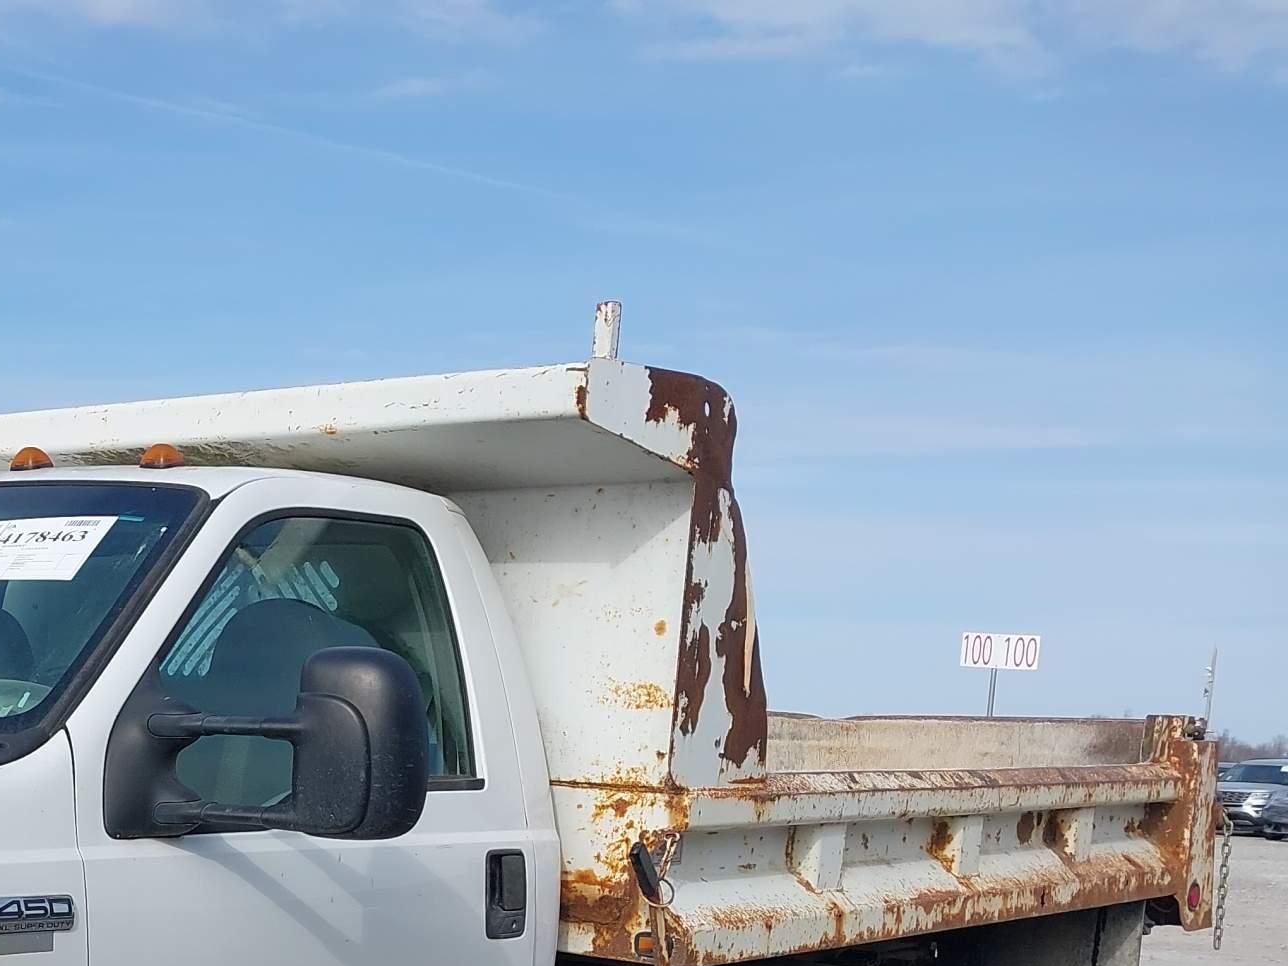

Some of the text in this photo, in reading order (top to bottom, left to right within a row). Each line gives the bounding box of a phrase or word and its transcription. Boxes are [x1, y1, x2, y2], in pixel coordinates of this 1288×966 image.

[964, 634, 1037, 667] 100 100
[14, 922, 46, 931] SUPER
[47, 921, 71, 929] DUTY
